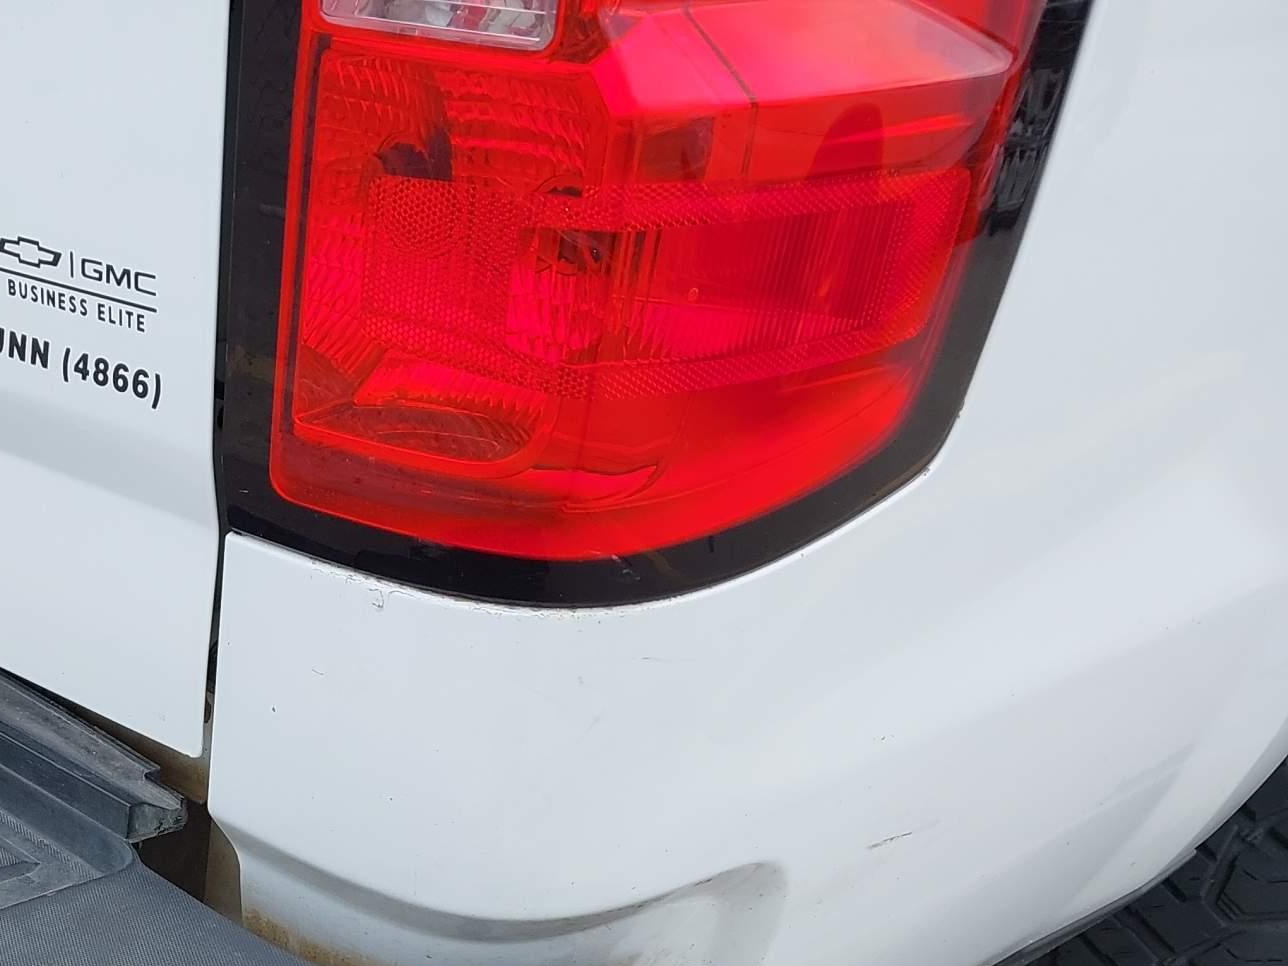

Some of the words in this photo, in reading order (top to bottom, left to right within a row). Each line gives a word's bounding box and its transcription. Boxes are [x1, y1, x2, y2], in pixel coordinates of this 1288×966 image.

[80, 257, 157, 297] GMC
[7, 278, 88, 317] BUSINESS
[97, 303, 146, 333] ELITE
[62, 346, 162, 410] (4866)
